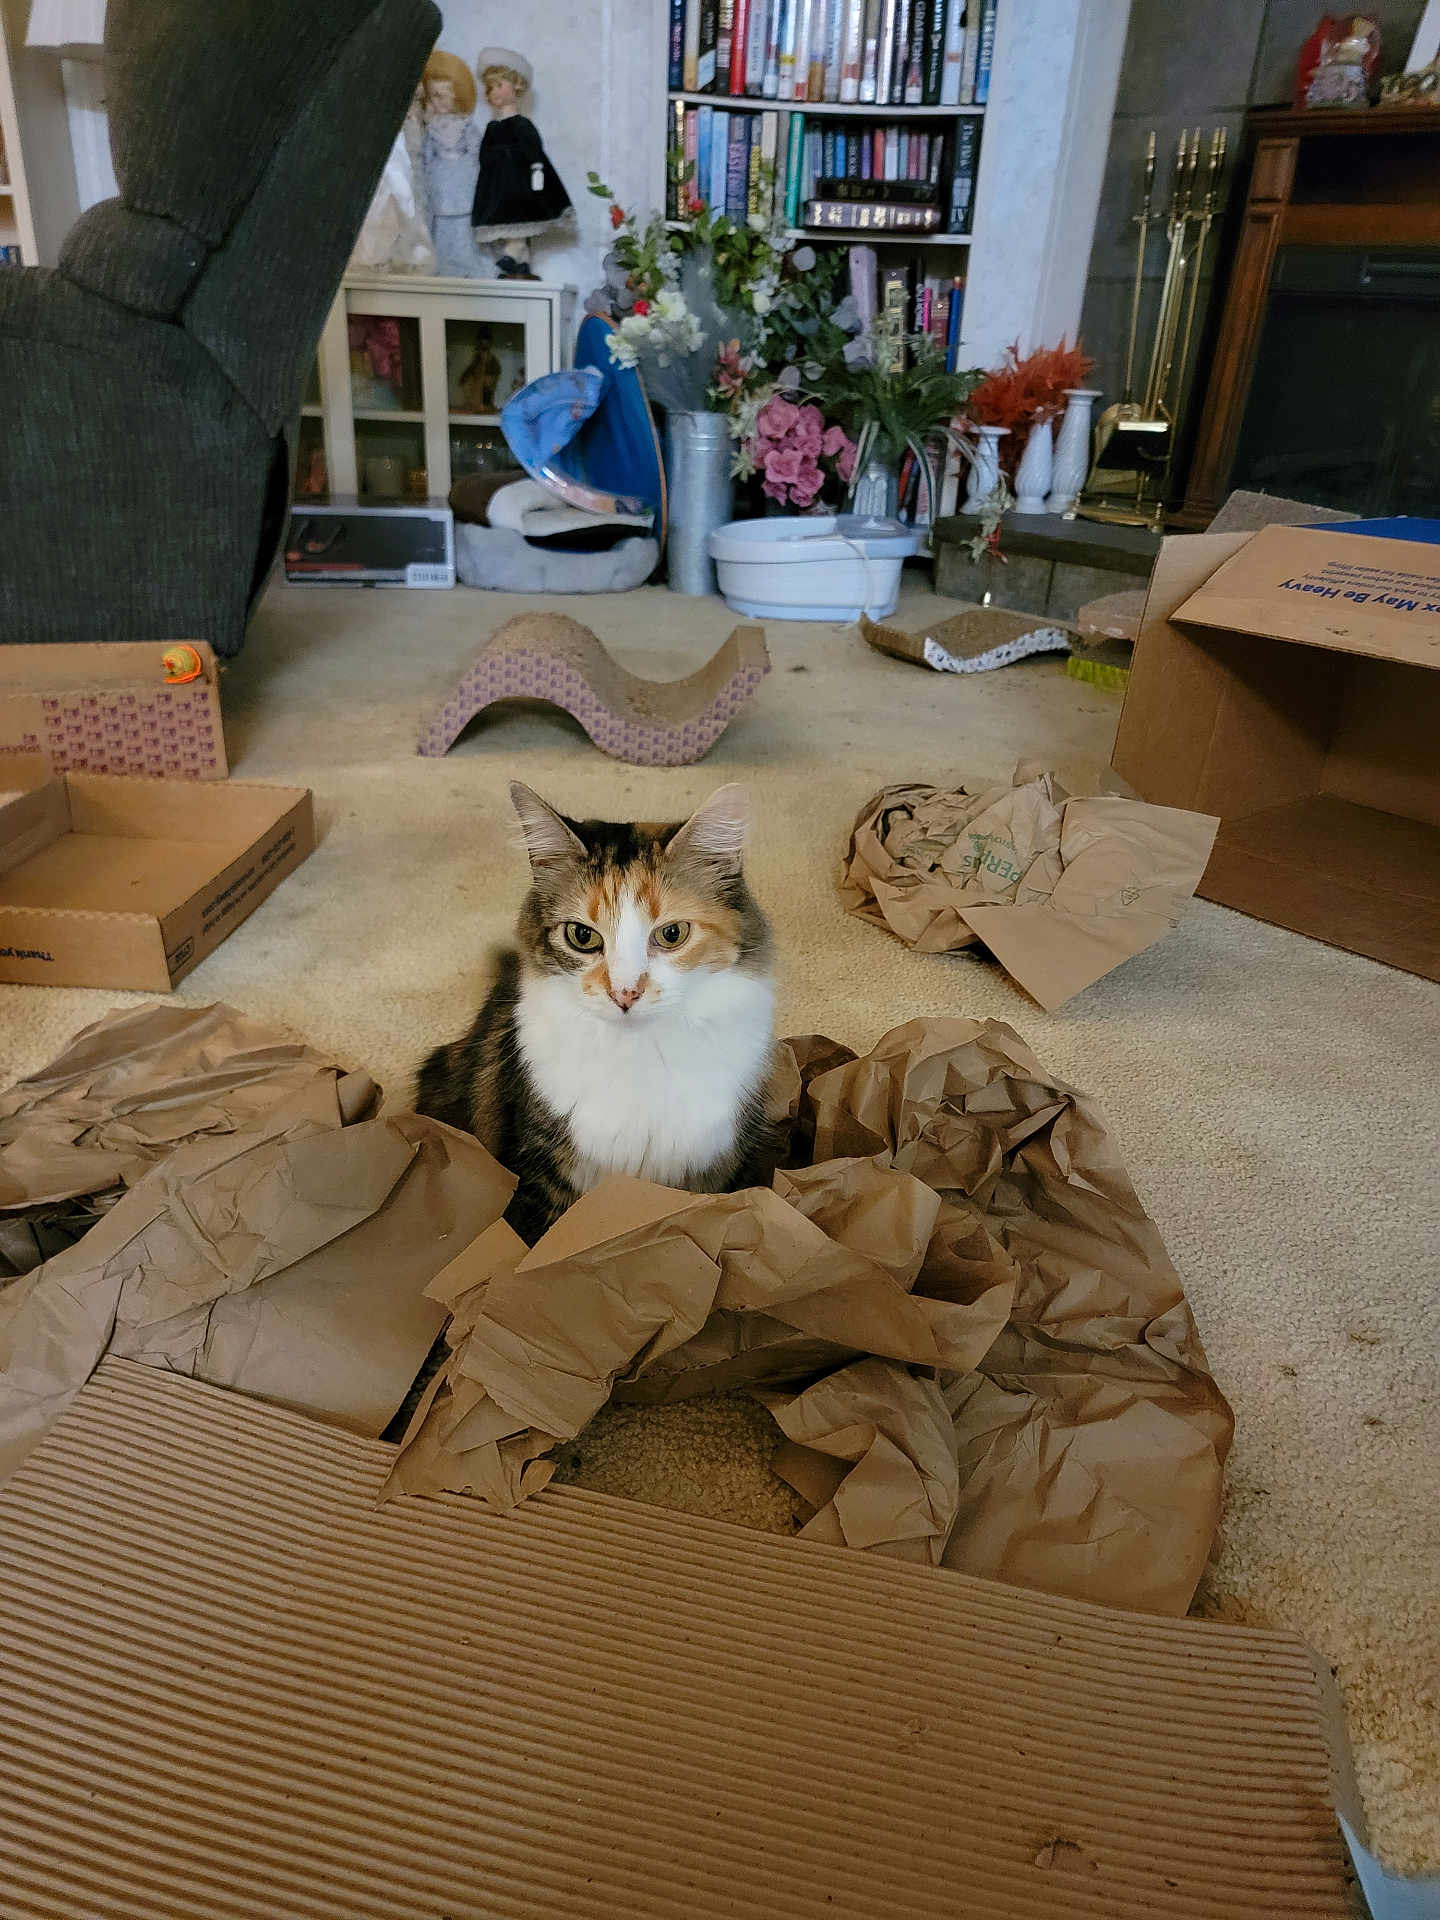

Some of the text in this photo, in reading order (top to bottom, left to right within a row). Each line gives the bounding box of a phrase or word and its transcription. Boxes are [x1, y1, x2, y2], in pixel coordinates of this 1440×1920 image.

[1277, 579, 1340, 599] Heavy
[1343, 591, 1370, 603] Be
[1371, 593, 1418, 611] May
[0, 947, 55, 962] Thank yo
